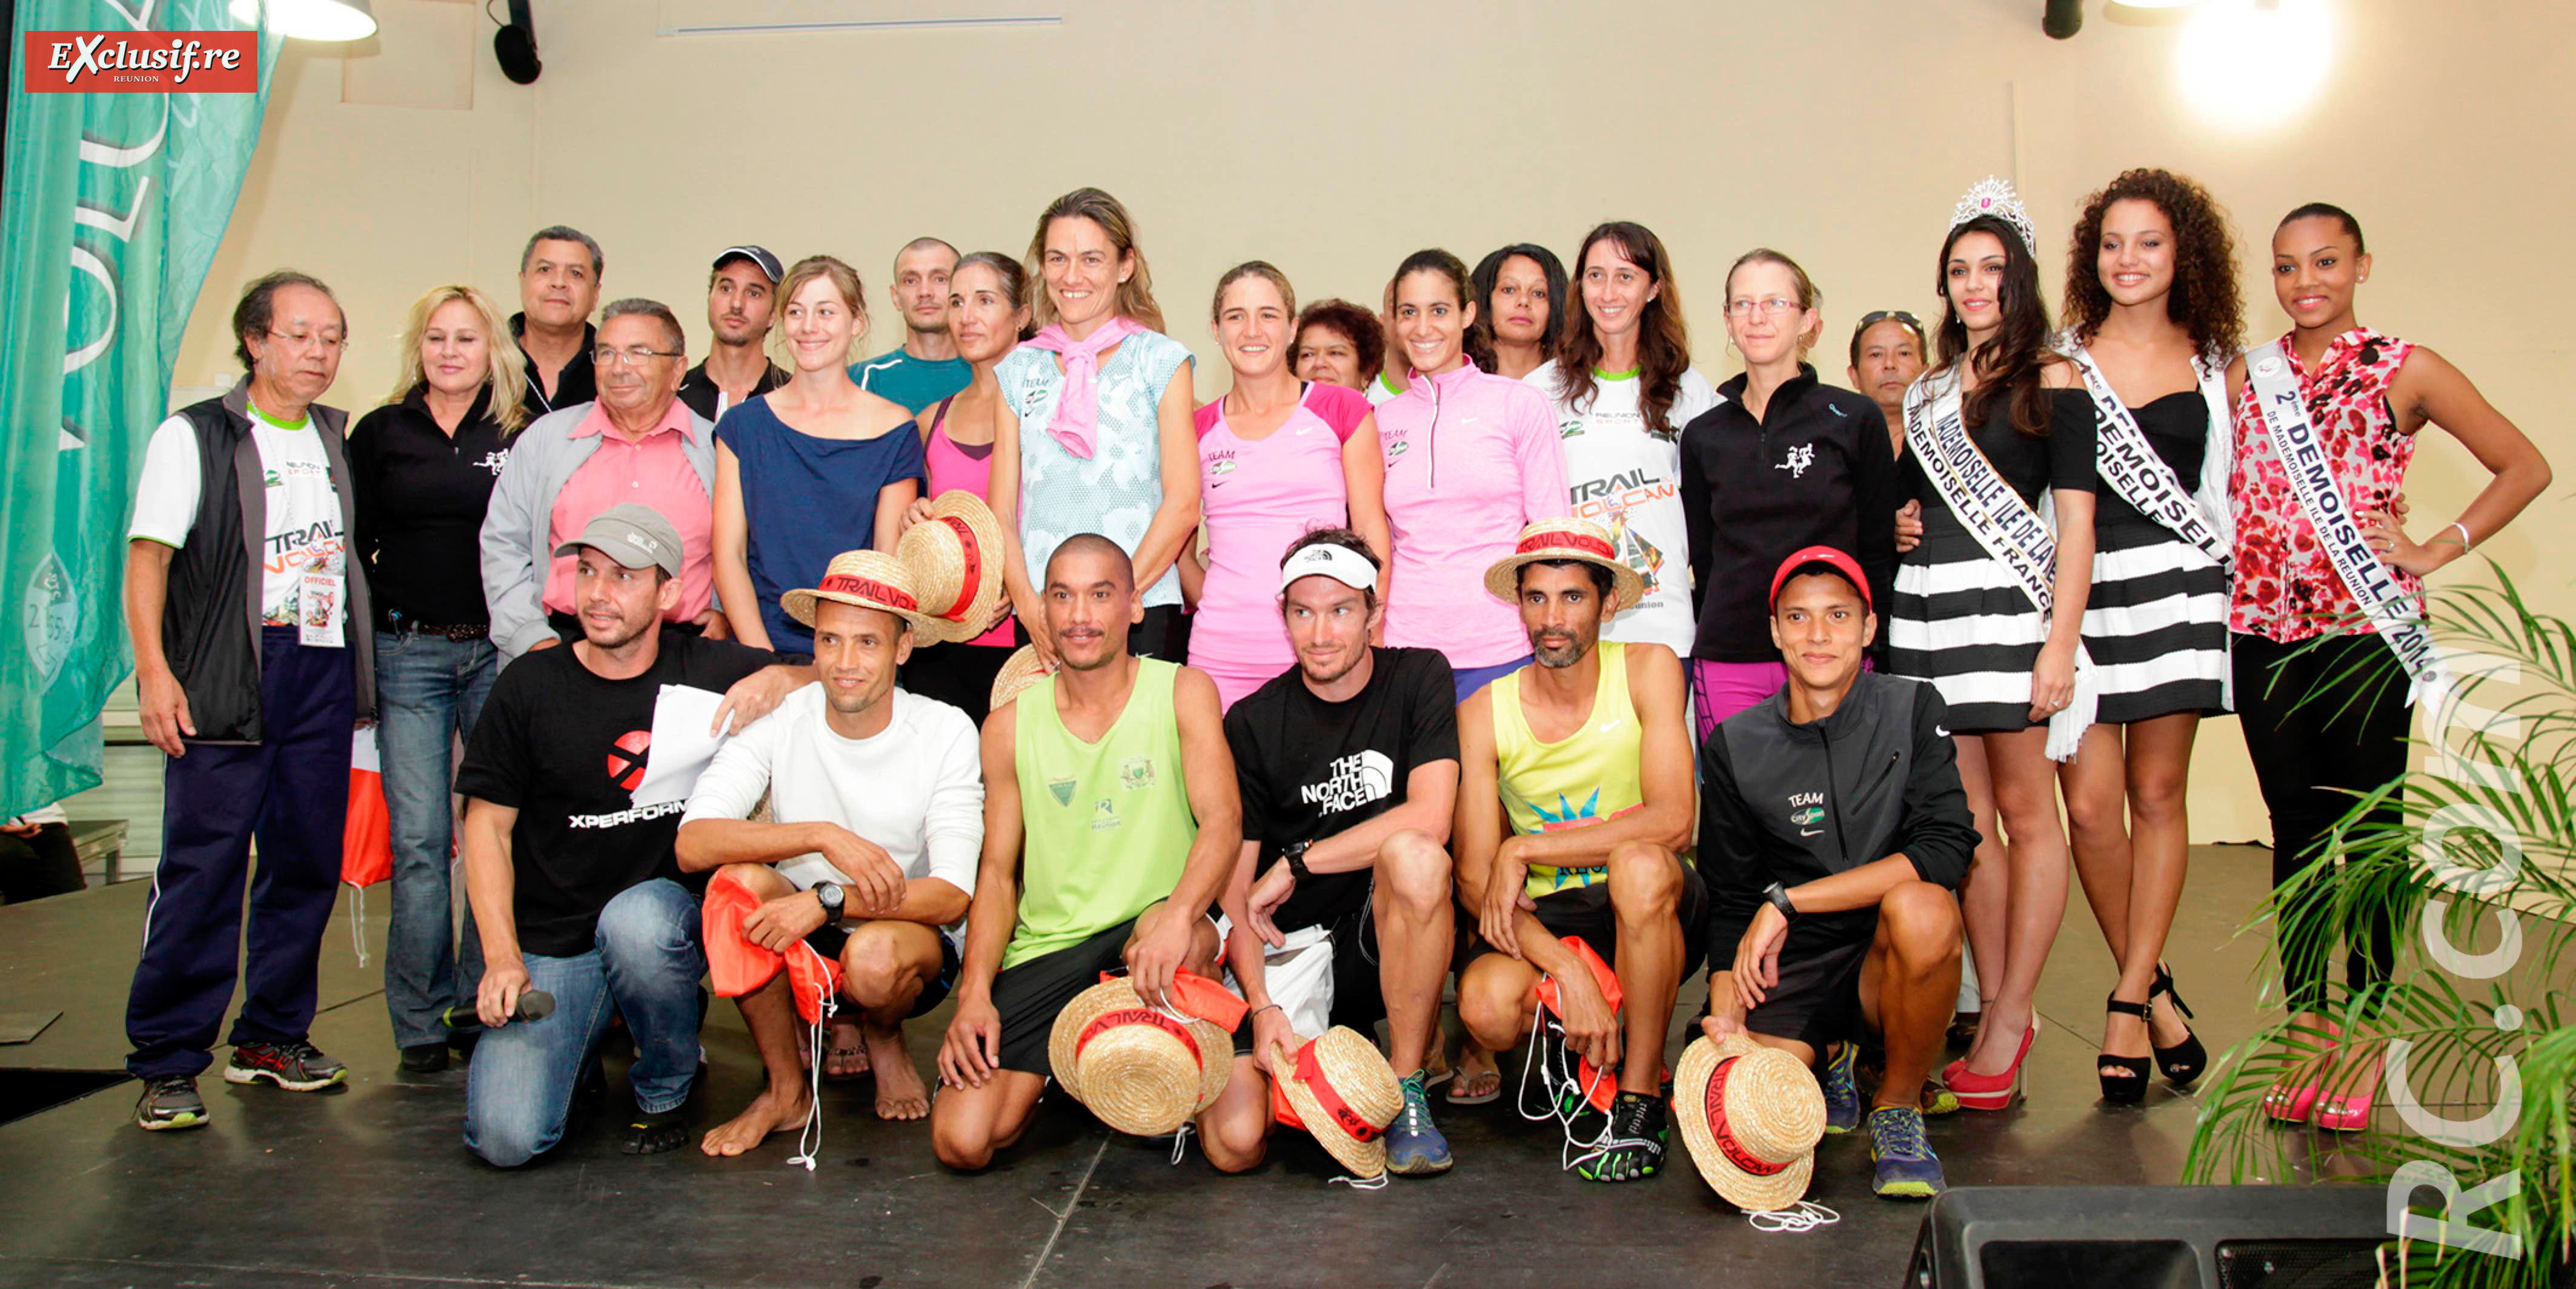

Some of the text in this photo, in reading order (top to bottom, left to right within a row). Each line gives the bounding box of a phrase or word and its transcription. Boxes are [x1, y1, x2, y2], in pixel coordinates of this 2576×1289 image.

[2267, 411, 2372, 606] DE MADEMOISELLE ILE DE LA REUNION
[2288, 422, 2409, 620] DEMOISELLE
[1991, 499, 2026, 531] ILE
[2010, 519, 2042, 548] DE
[2027, 536, 2054, 567] LA
[305, 576, 336, 586] OFFICIEL
[838, 577, 886, 601] TRAIL
[1992, 537, 2052, 623] FRANCE
[1330, 753, 1363, 777] THE
[1301, 771, 1363, 804] NORTH
[1323, 787, 1367, 815] FACE
[1788, 792, 1824, 807] TEAM
[1107, 1011, 1167, 1029] TRAIL
[1709, 1072, 1726, 1126] TRAIL
